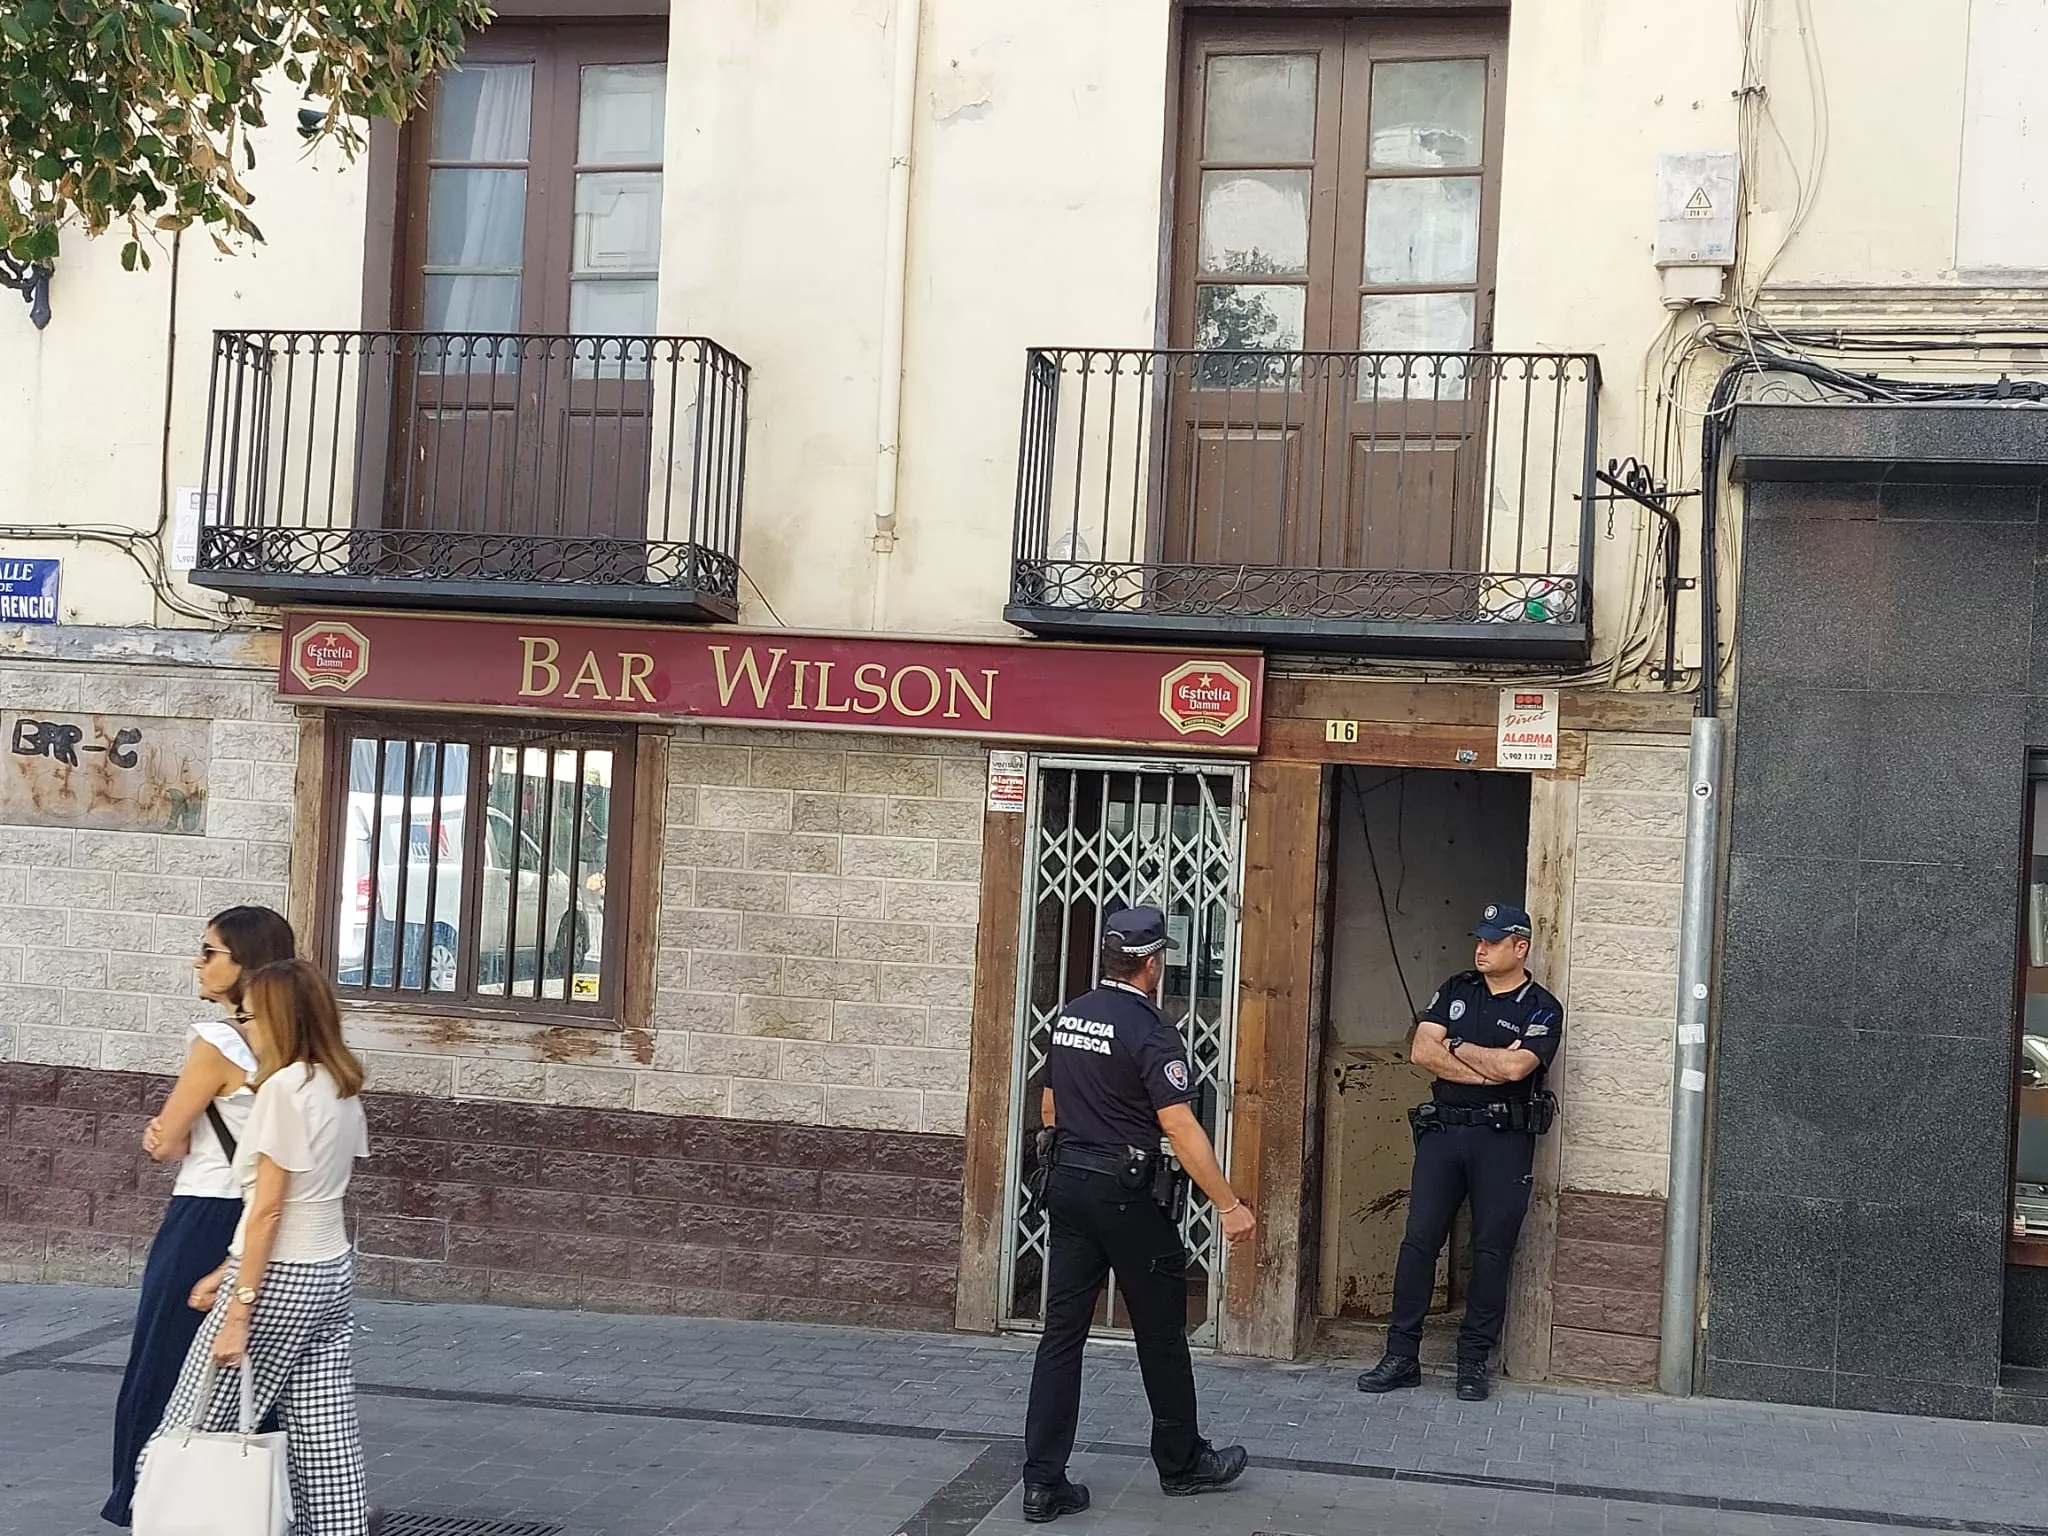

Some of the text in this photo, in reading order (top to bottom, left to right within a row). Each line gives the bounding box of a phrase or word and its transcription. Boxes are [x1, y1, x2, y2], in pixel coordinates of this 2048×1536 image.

[0, 563, 34, 581] LLE
[1, 595, 54, 619] RENCIO
[307, 643, 352, 659] Estrella
[316, 657, 343, 668] Damm
[517, 636, 999, 721] BAR WILSON
[1178, 685, 1231, 701] Estrella
[1189, 699, 1220, 711] Damm
[1331, 722, 1354, 741] 16
[1502, 732, 1553, 744] ALARMA
[1056, 1015, 1115, 1039] POLICIA
[1052, 1031, 1112, 1055] HUESCA
